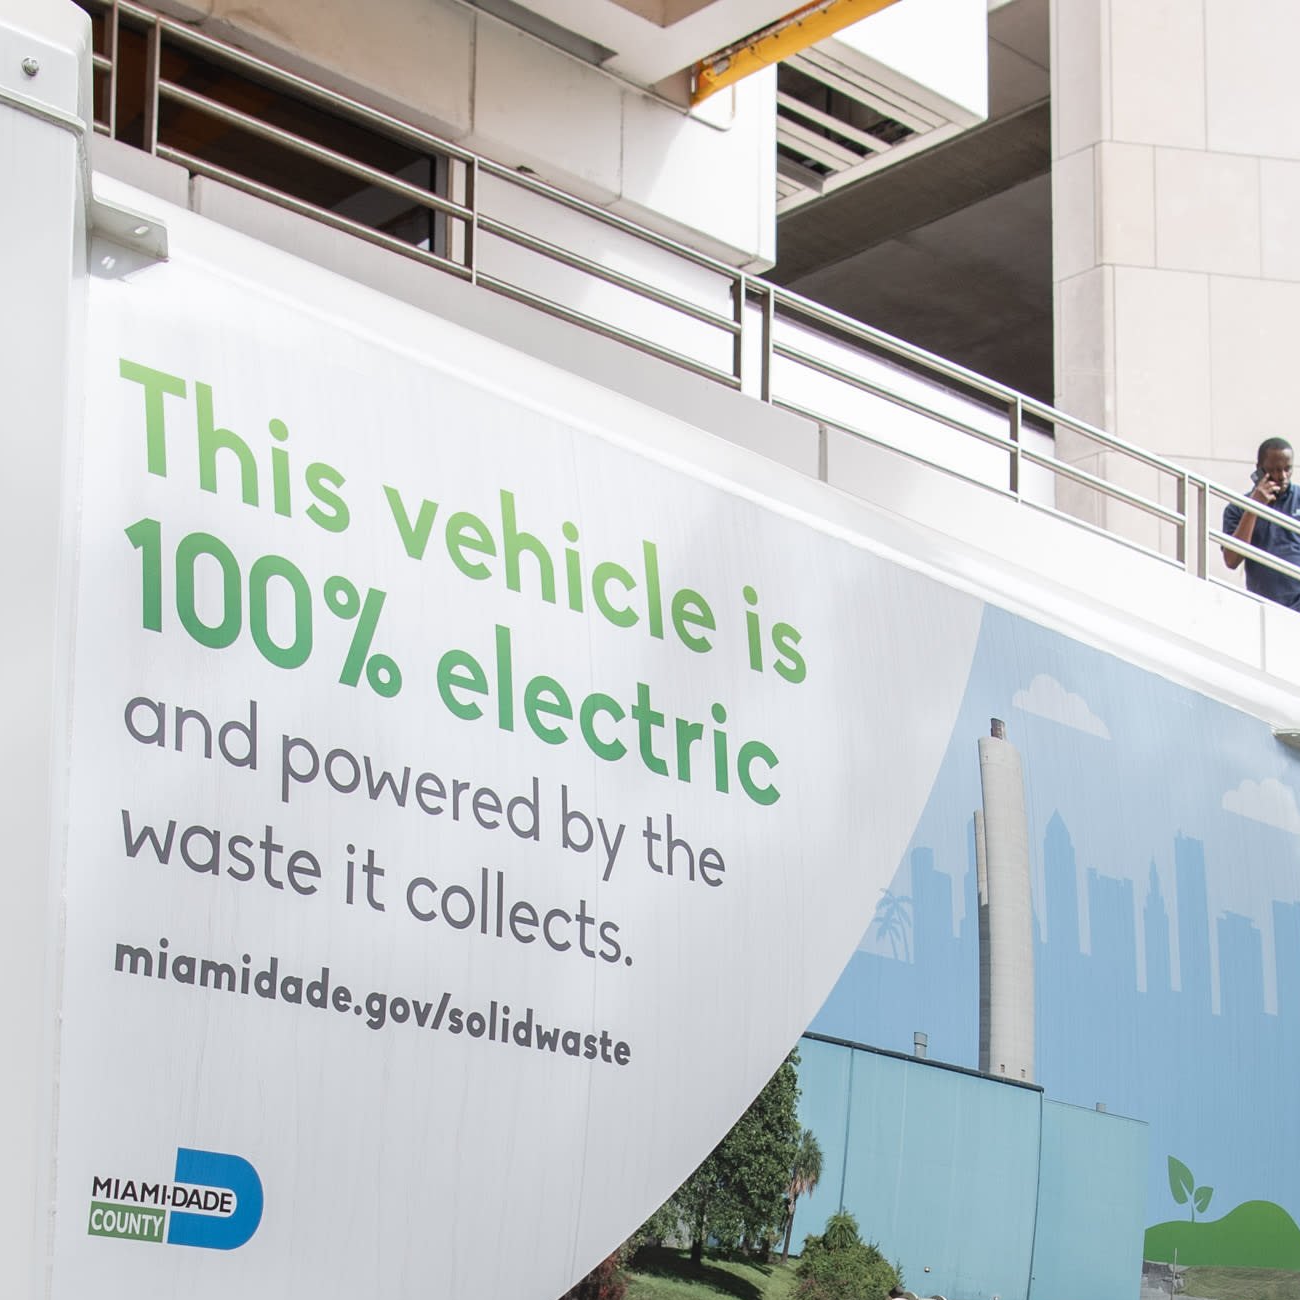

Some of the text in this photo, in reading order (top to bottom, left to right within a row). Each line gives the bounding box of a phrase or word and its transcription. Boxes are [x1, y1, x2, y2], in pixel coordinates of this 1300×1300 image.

[119, 357, 807, 684] This vehicle is
[123, 517, 781, 806] 100% electric
[123, 696, 726, 887] and powered by the
[121, 810, 633, 967] waste it collects.
[114, 938, 631, 1066] miamidade.gov/solidwaste
[91, 1208, 163, 1237] COUNTY
